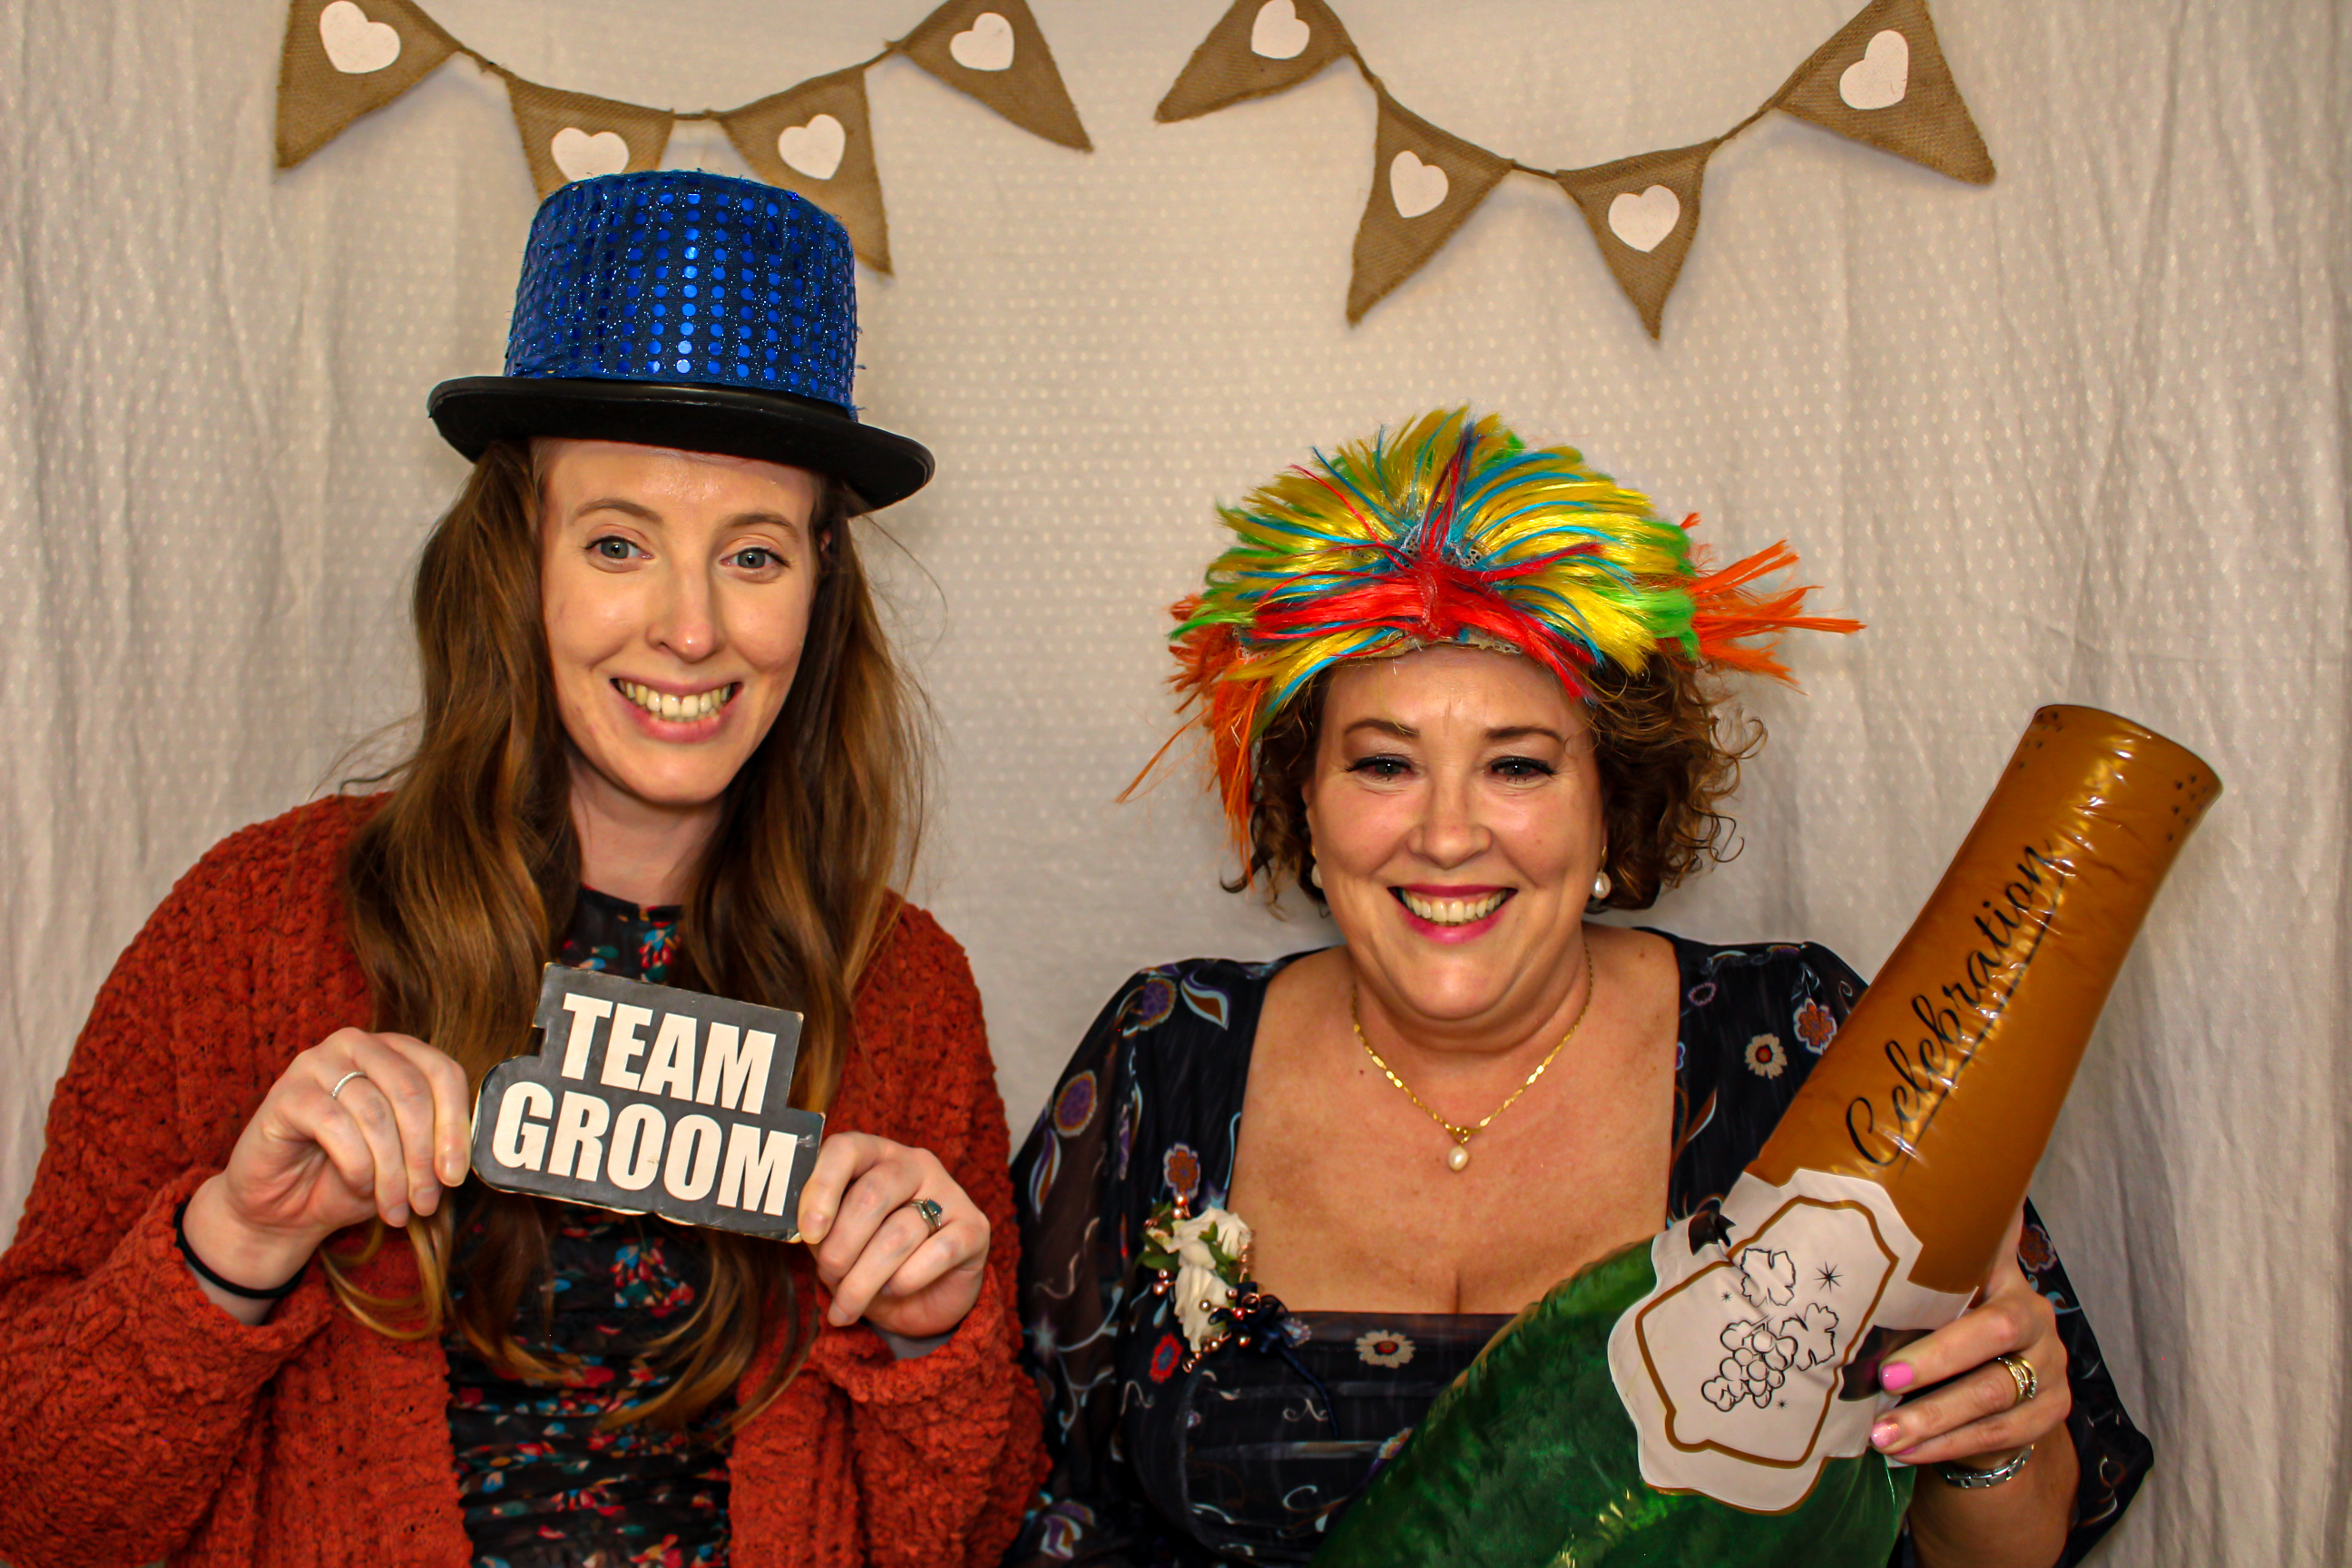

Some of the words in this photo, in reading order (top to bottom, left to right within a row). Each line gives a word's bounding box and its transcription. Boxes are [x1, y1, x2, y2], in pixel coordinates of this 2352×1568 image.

[561, 993, 777, 1114] TEAM
[1846, 838, 2065, 1169] Celebration
[492, 1081, 799, 1217] GROOM
